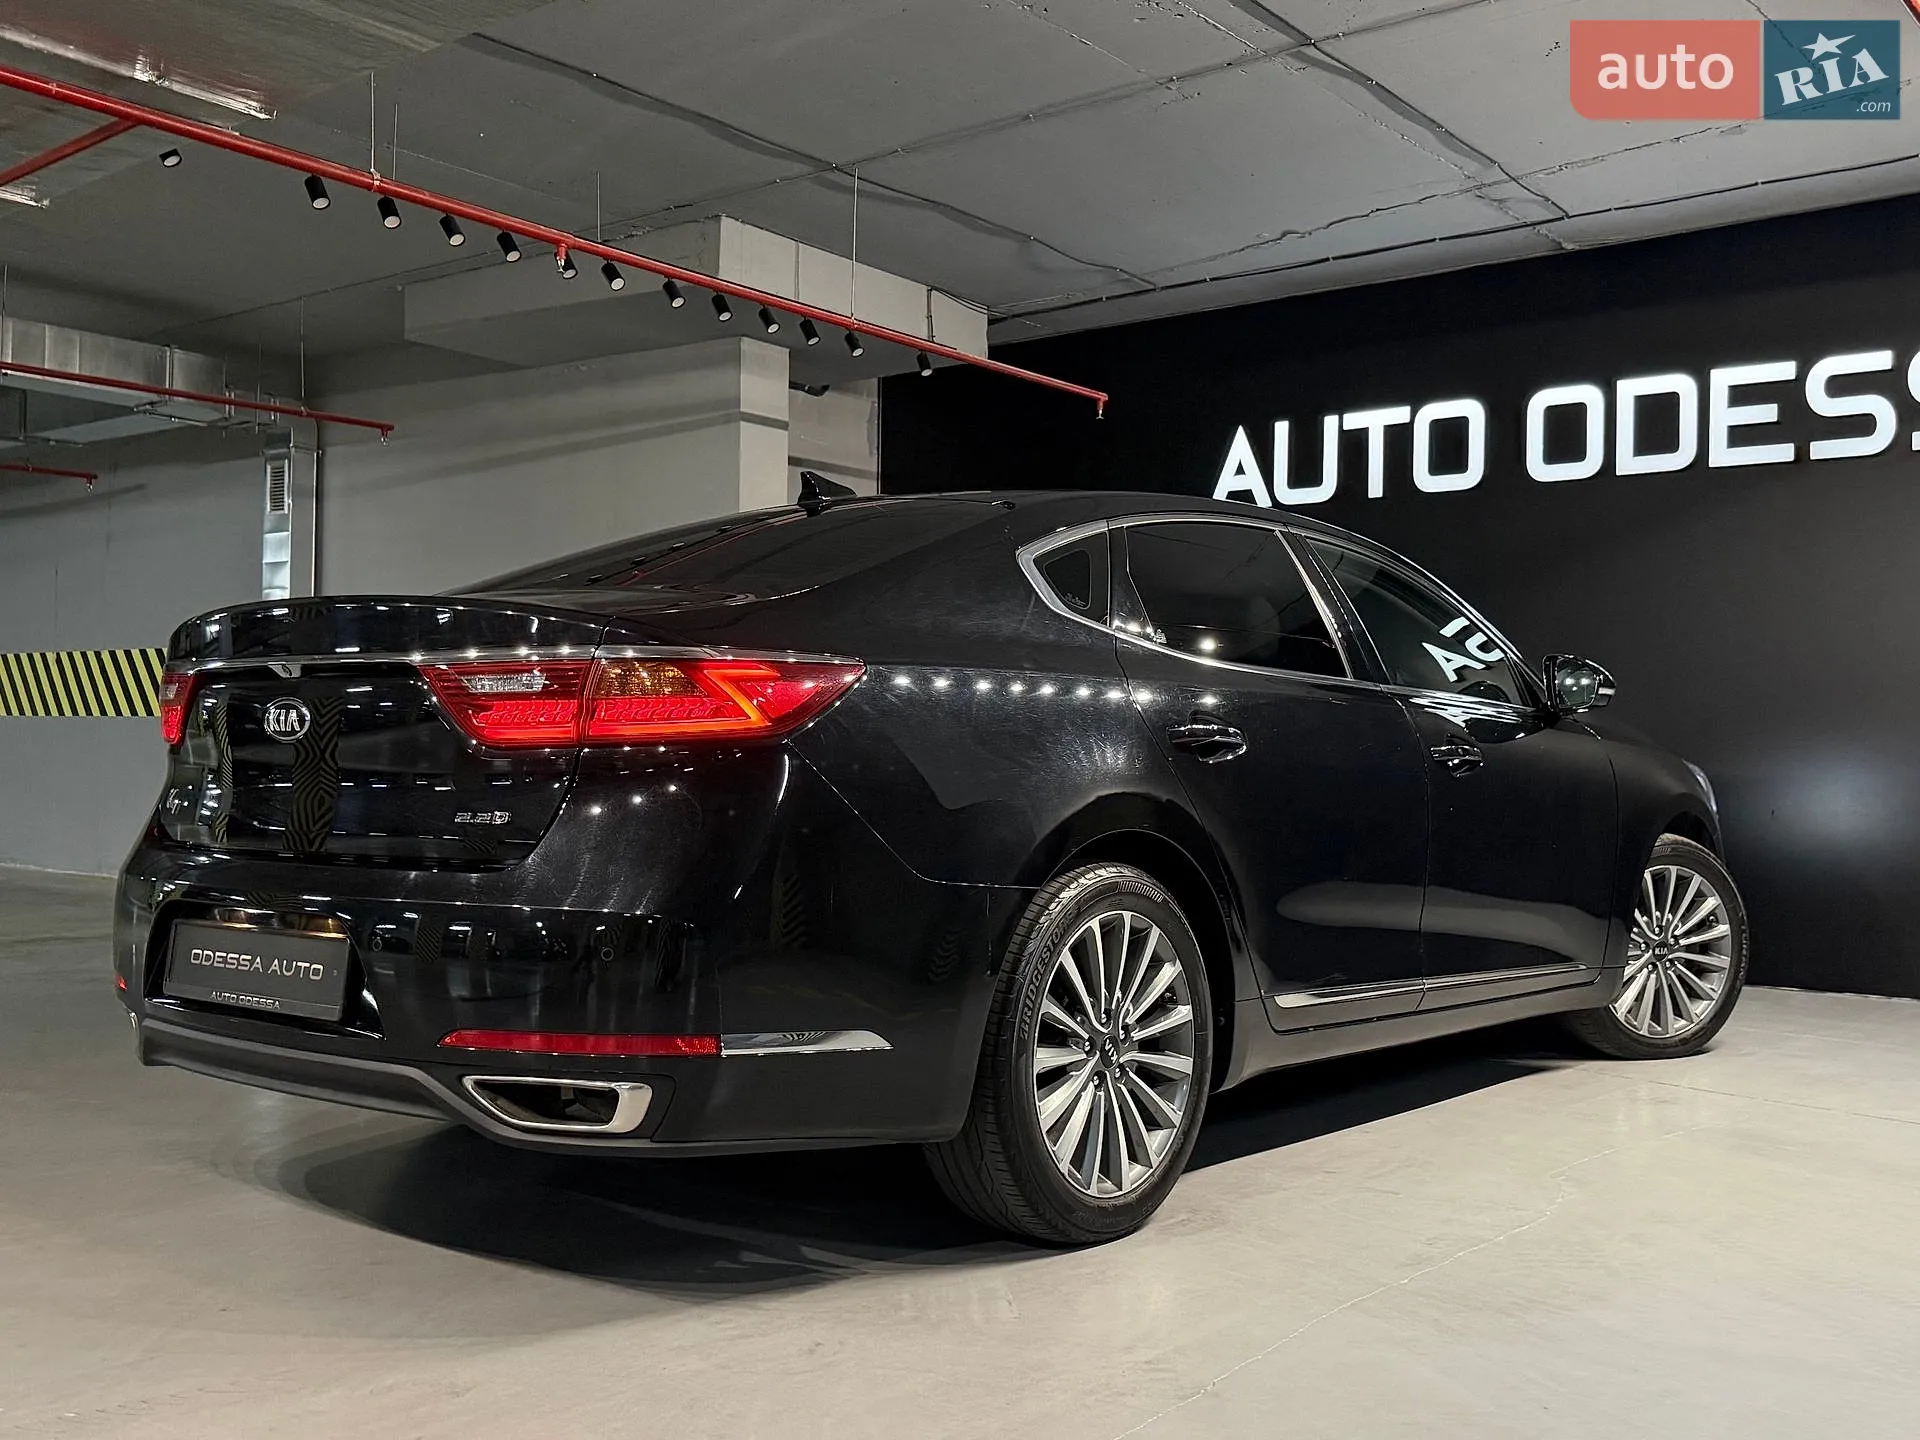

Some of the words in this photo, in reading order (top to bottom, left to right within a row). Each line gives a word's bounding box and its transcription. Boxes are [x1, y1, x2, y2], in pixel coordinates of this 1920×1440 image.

[1213, 398, 1486, 508] AUTO
[1526, 346, 1920, 483] ODES
[269, 708, 301, 732] KIA
[190, 949, 263, 973] ODESSA
[267, 957, 324, 981] AUTO
[210, 991, 237, 1004] AUTO
[238, 994, 281, 1010] ODESSA
[1104, 1038, 1119, 1064] KIA
